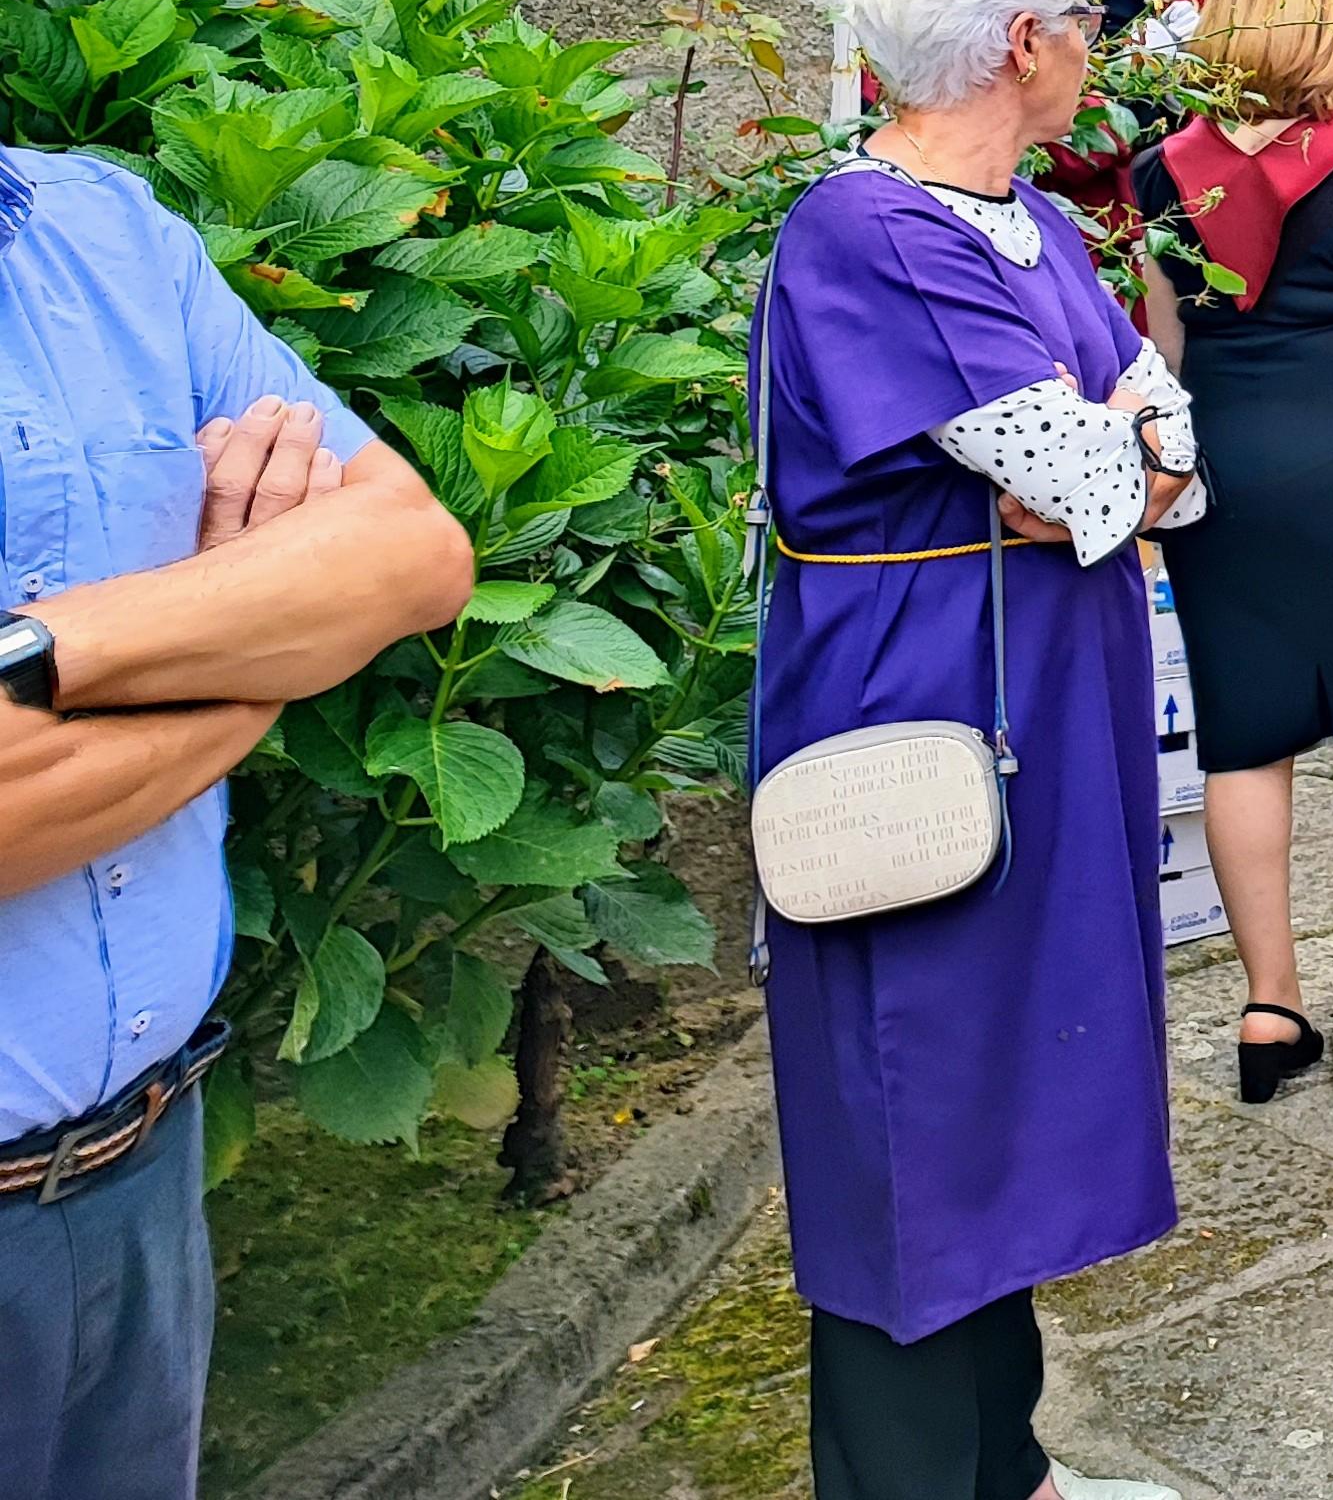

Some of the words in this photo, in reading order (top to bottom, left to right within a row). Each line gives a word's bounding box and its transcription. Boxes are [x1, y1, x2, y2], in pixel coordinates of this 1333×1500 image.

[833, 777, 897, 799] GEORGES
[900, 765, 938, 785] RECH
[815, 812, 880, 836] GEORGES
[800, 851, 838, 872] RECH
[892, 848, 930, 868] RECH
[828, 878, 867, 896] RECH
